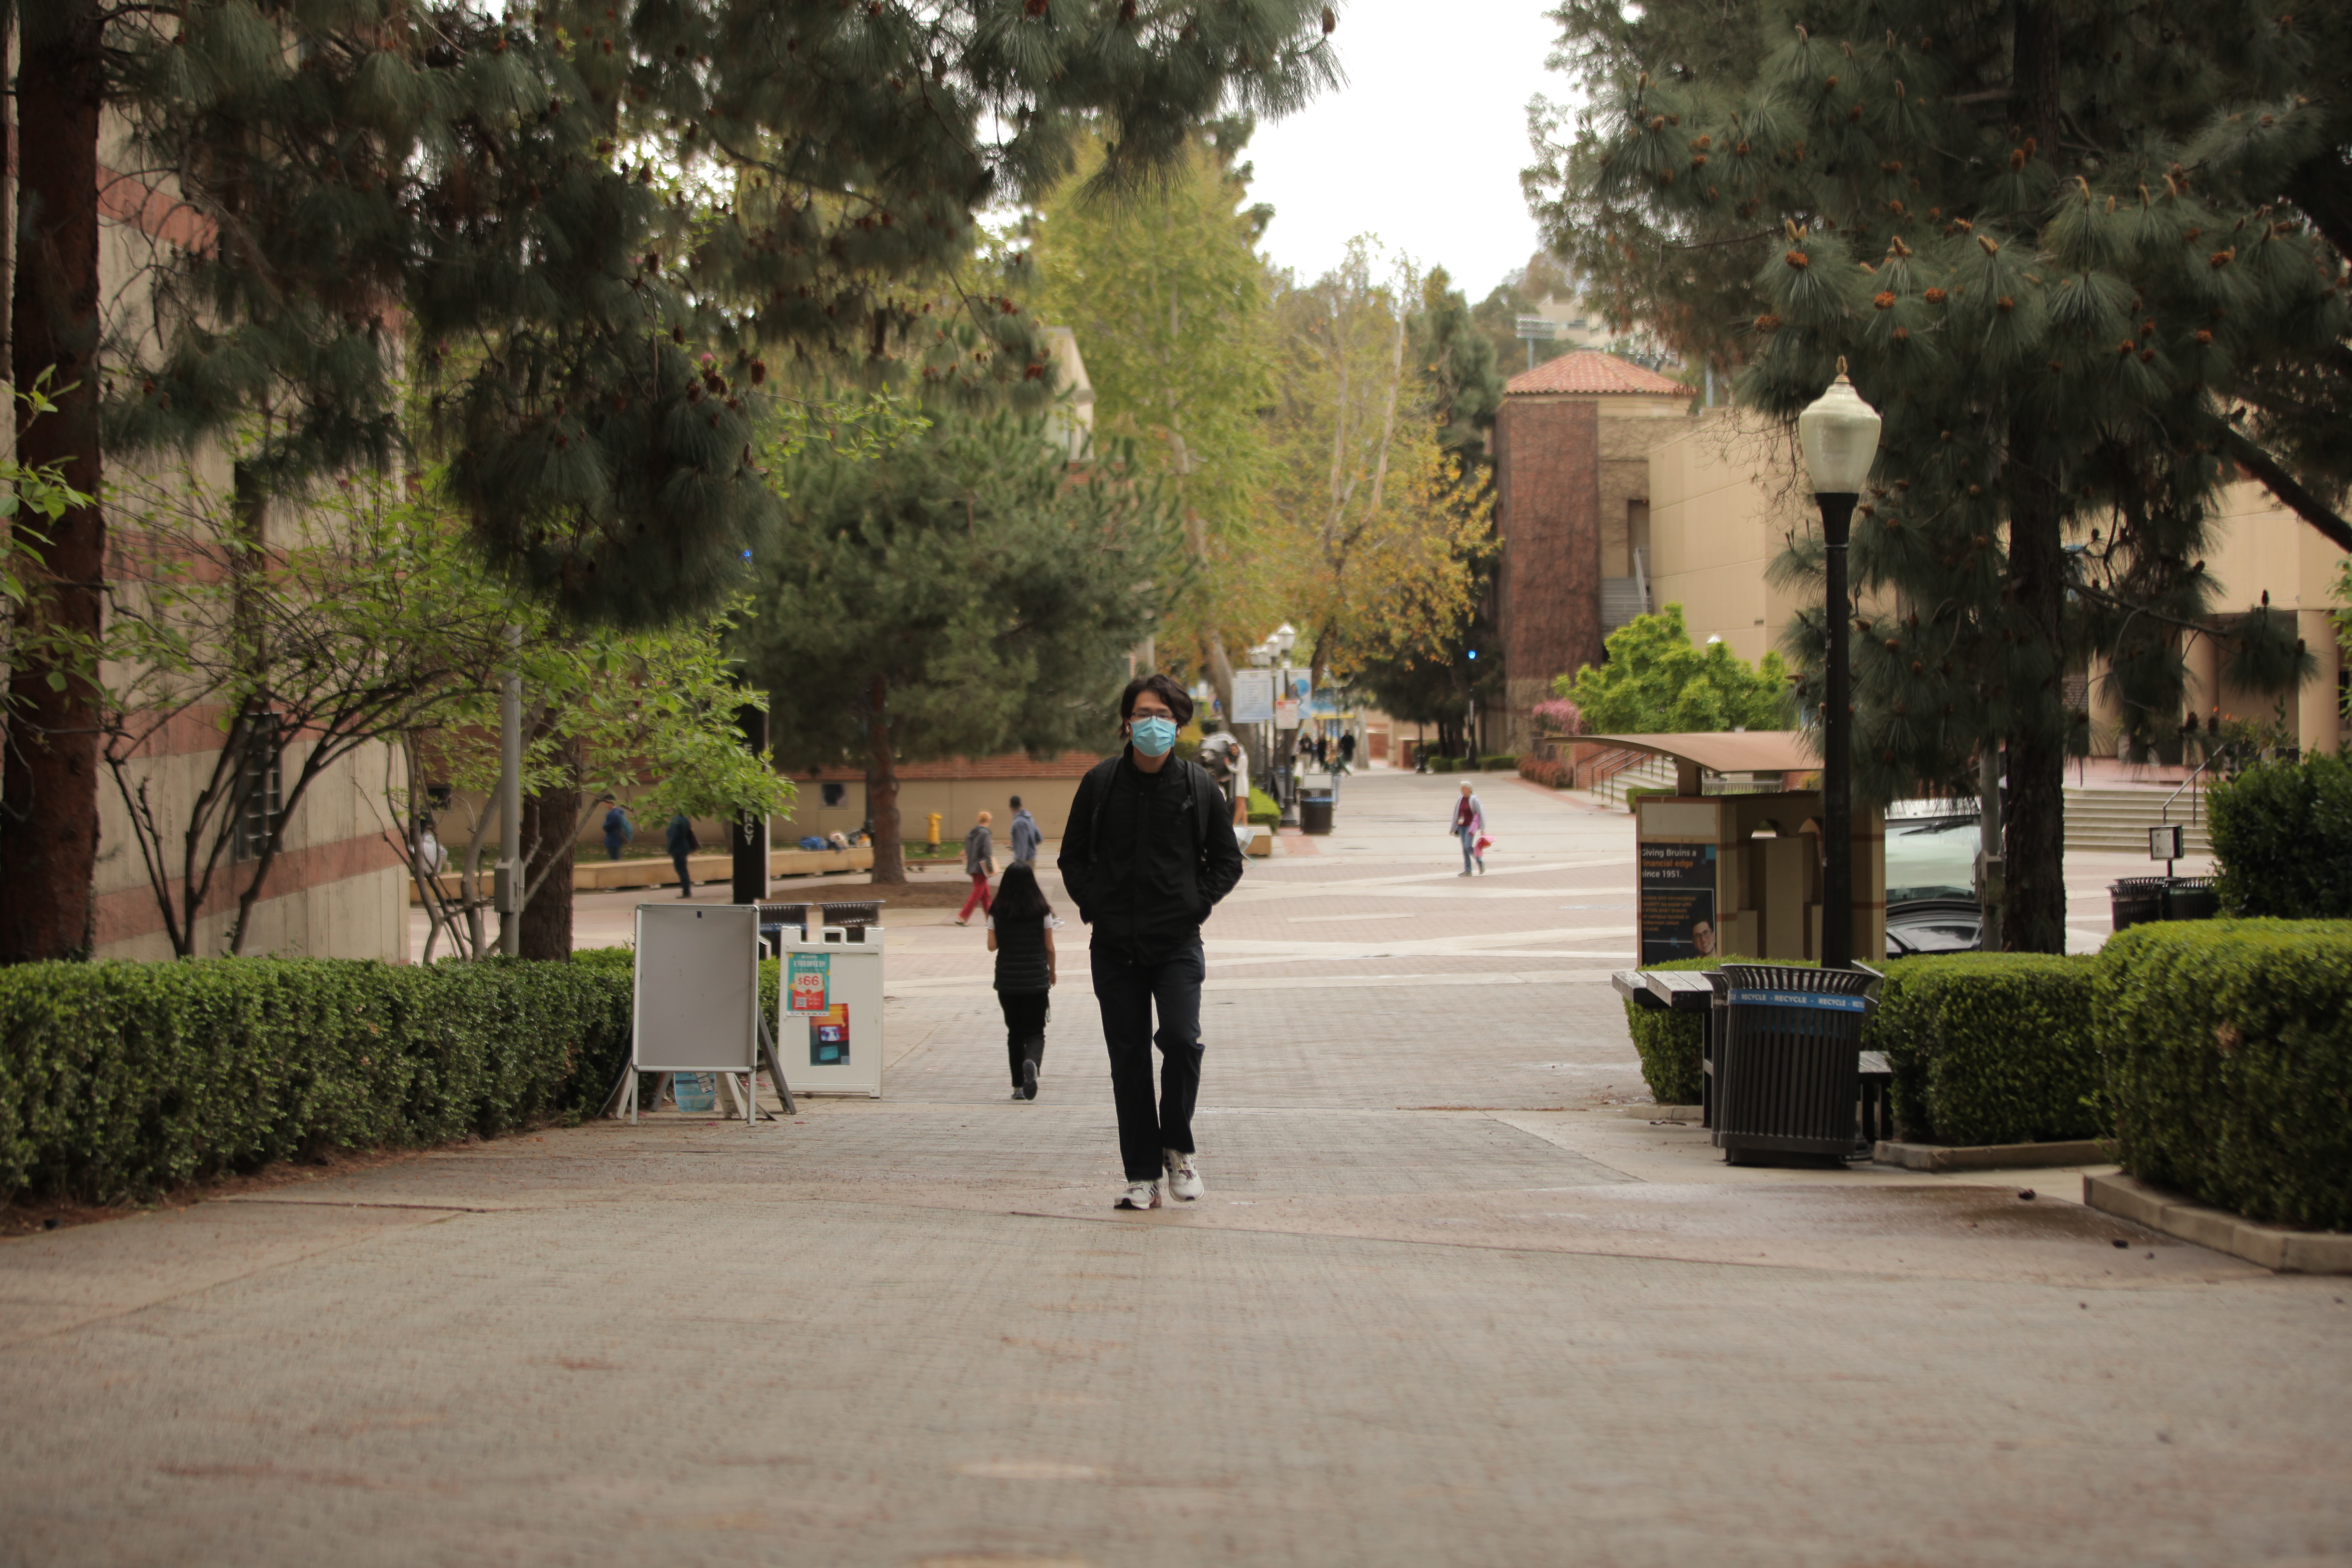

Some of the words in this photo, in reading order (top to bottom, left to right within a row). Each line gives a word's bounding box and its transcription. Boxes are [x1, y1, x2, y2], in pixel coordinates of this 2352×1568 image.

[1642, 848, 1664, 858] Giving
[1675, 860, 1694, 869] edge
[798, 976, 819, 986] $66
[1818, 998, 1846, 1006] RECYCLE
